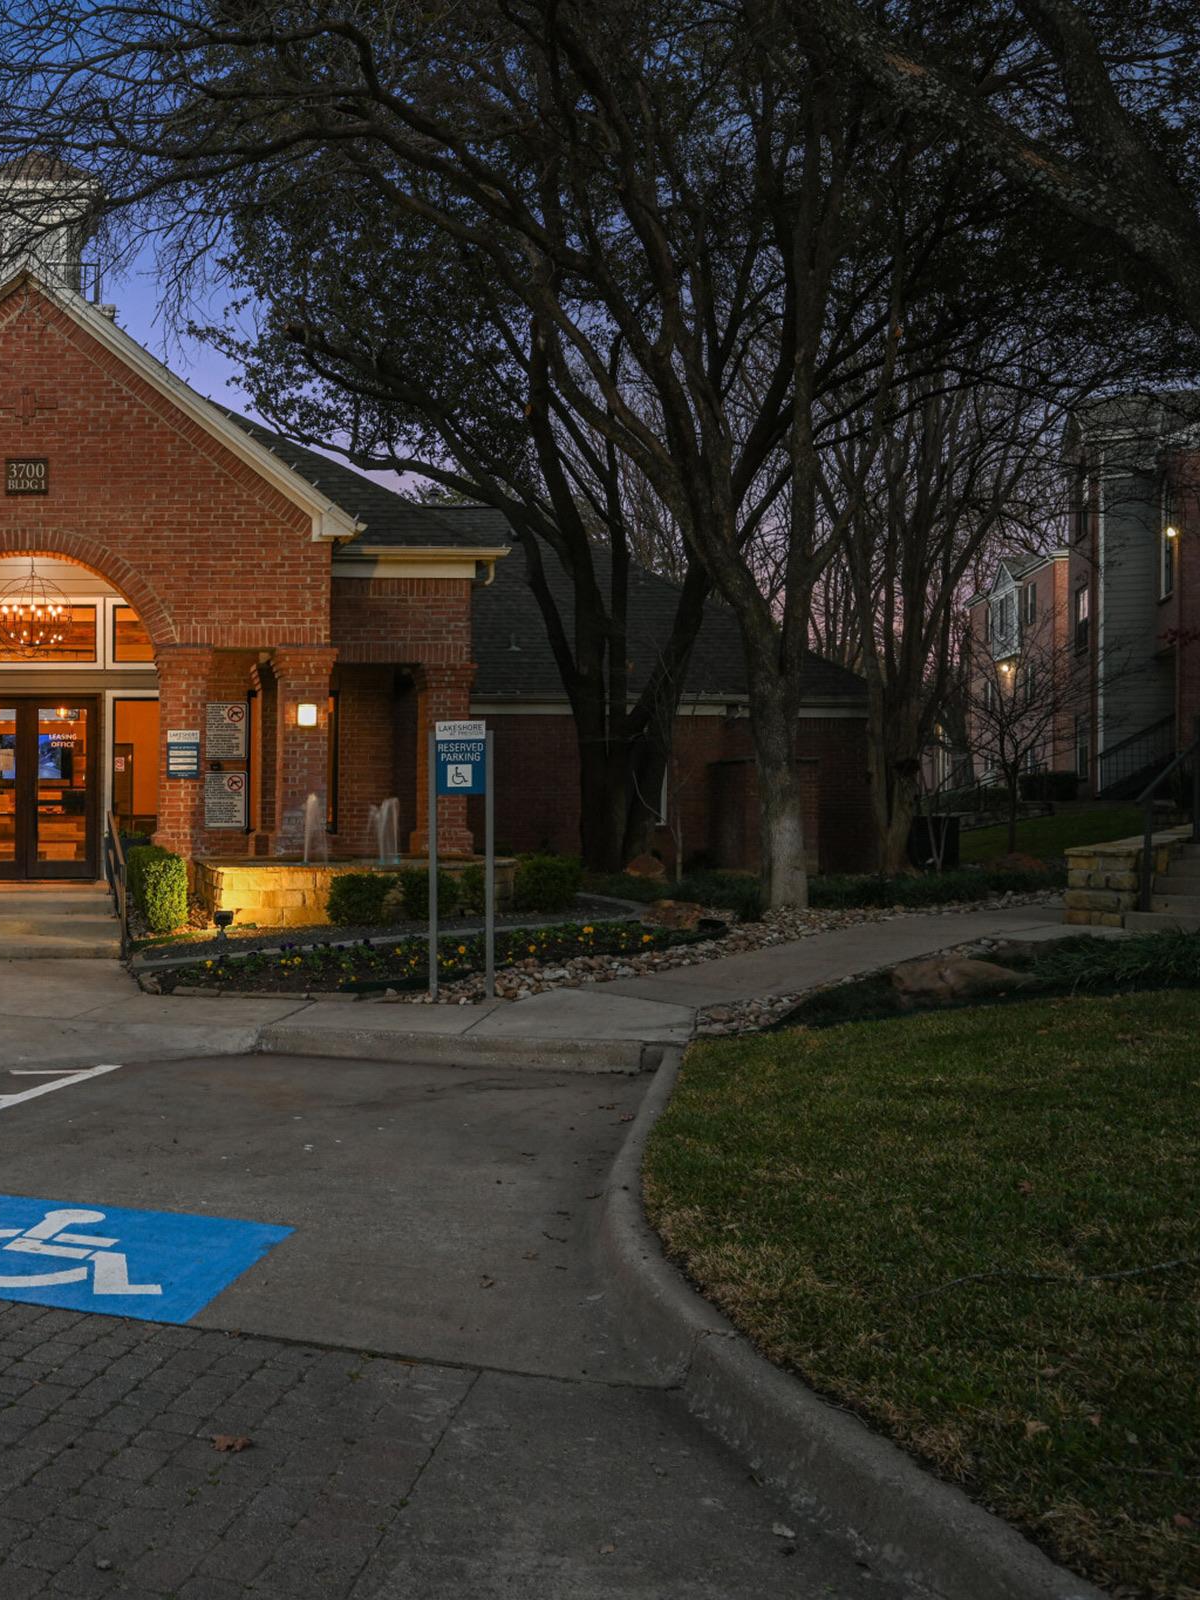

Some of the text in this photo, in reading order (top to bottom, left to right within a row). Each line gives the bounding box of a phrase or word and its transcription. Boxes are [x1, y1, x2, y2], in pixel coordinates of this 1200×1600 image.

[9, 463, 45, 478] 3700
[8, 480, 46, 490] BLDG 1
[438, 723, 484, 732] LAKESHORE
[48, 733, 78, 741] LEASING
[438, 742, 484, 752] RESERVED
[441, 752, 481, 762] PARKING
